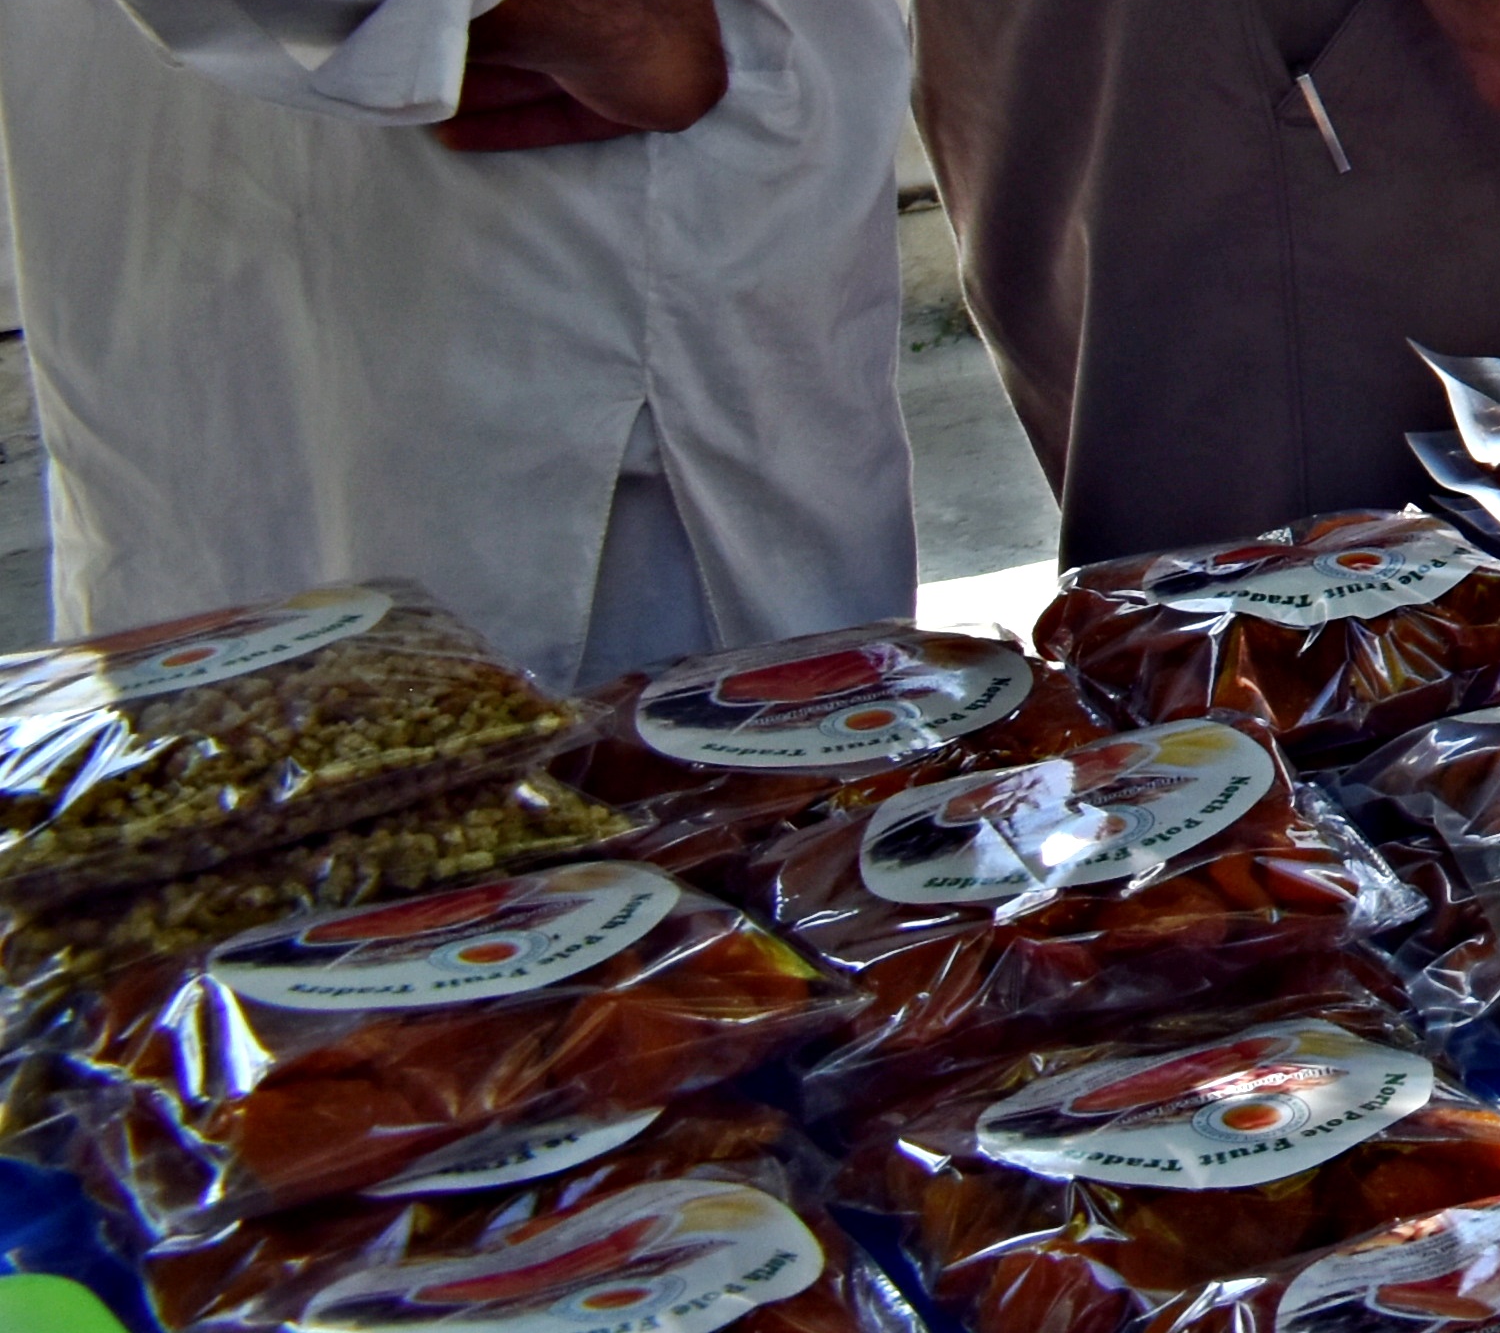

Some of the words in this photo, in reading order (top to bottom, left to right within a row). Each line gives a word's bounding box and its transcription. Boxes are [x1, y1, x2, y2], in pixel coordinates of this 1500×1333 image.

[960, 675, 1012, 720] North
[700, 742, 808, 758] Traders
[1200, 775, 1252, 816] North
[1140, 816, 1202, 848] Pole
[1360, 1072, 1407, 1113] North
[1300, 1110, 1361, 1139] Pole
[1198, 1135, 1294, 1167] Fruit
